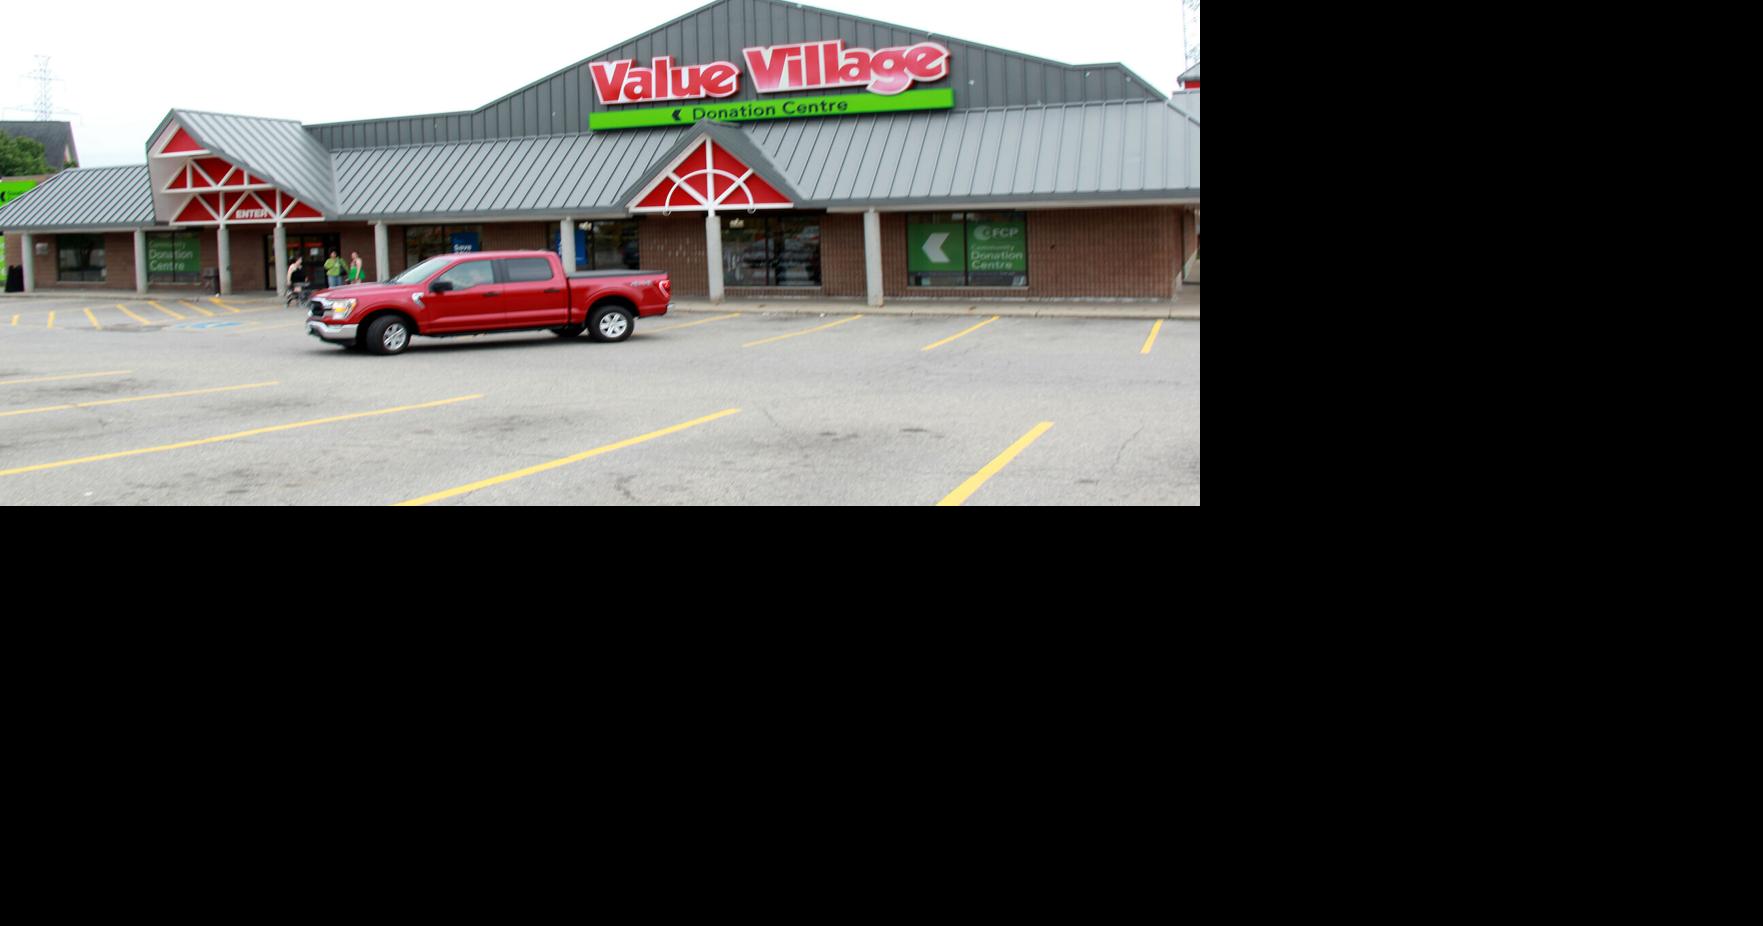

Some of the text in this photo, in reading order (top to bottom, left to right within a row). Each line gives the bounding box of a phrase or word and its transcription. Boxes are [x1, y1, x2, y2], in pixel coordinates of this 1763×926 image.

[590, 39, 950, 105] Value Village
[693, 100, 848, 121] Donation Centre
[236, 208, 267, 219] ENTER
[149, 249, 193, 260] Donation
[971, 251, 1023, 261] Donation
[150, 260, 185, 271] Centre
[972, 260, 1013, 270] Centre
